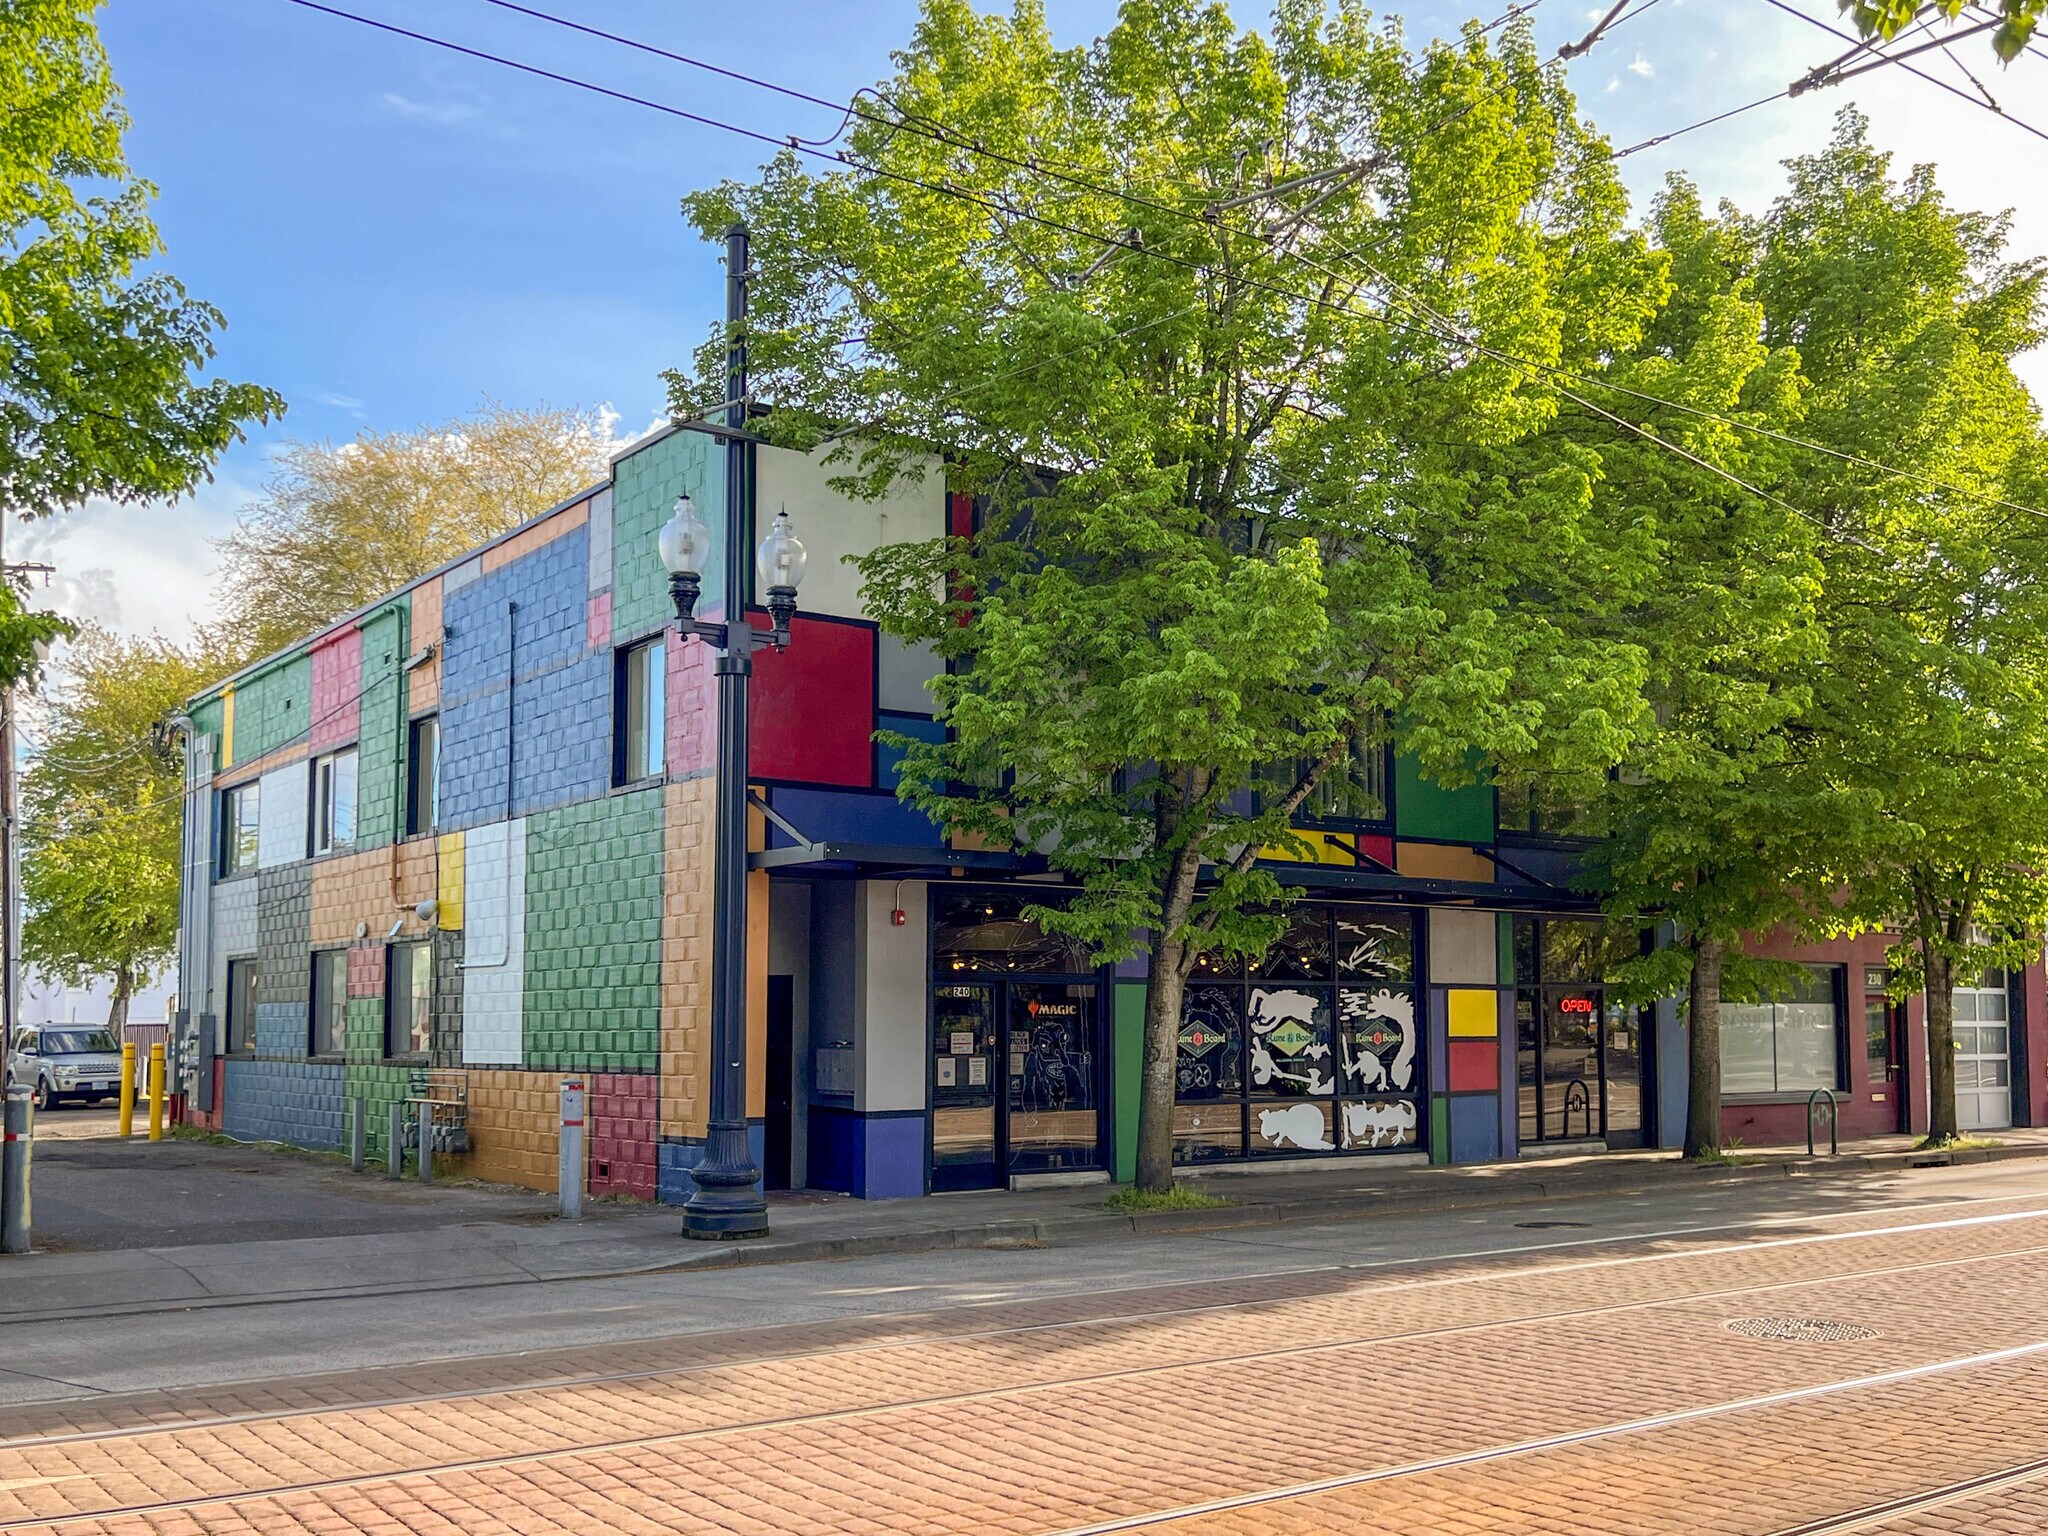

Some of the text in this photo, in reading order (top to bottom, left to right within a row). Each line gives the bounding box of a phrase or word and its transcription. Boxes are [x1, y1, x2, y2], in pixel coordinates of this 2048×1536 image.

[1867, 973, 1882, 986] 230
[954, 987, 969, 996] 240
[1038, 1004, 1077, 1015] MAGIC
[1561, 998, 1593, 1013] OPEN
[1784, 1012, 1829, 1029] CHURCH
[1178, 1036, 1193, 1044] une
[1203, 1033, 1226, 1044] Board
[1266, 1033, 1285, 1043] Rune
[1287, 1033, 1293, 1043] &
[1355, 1033, 1373, 1043] Rune
[1382, 1033, 1402, 1042] Board
